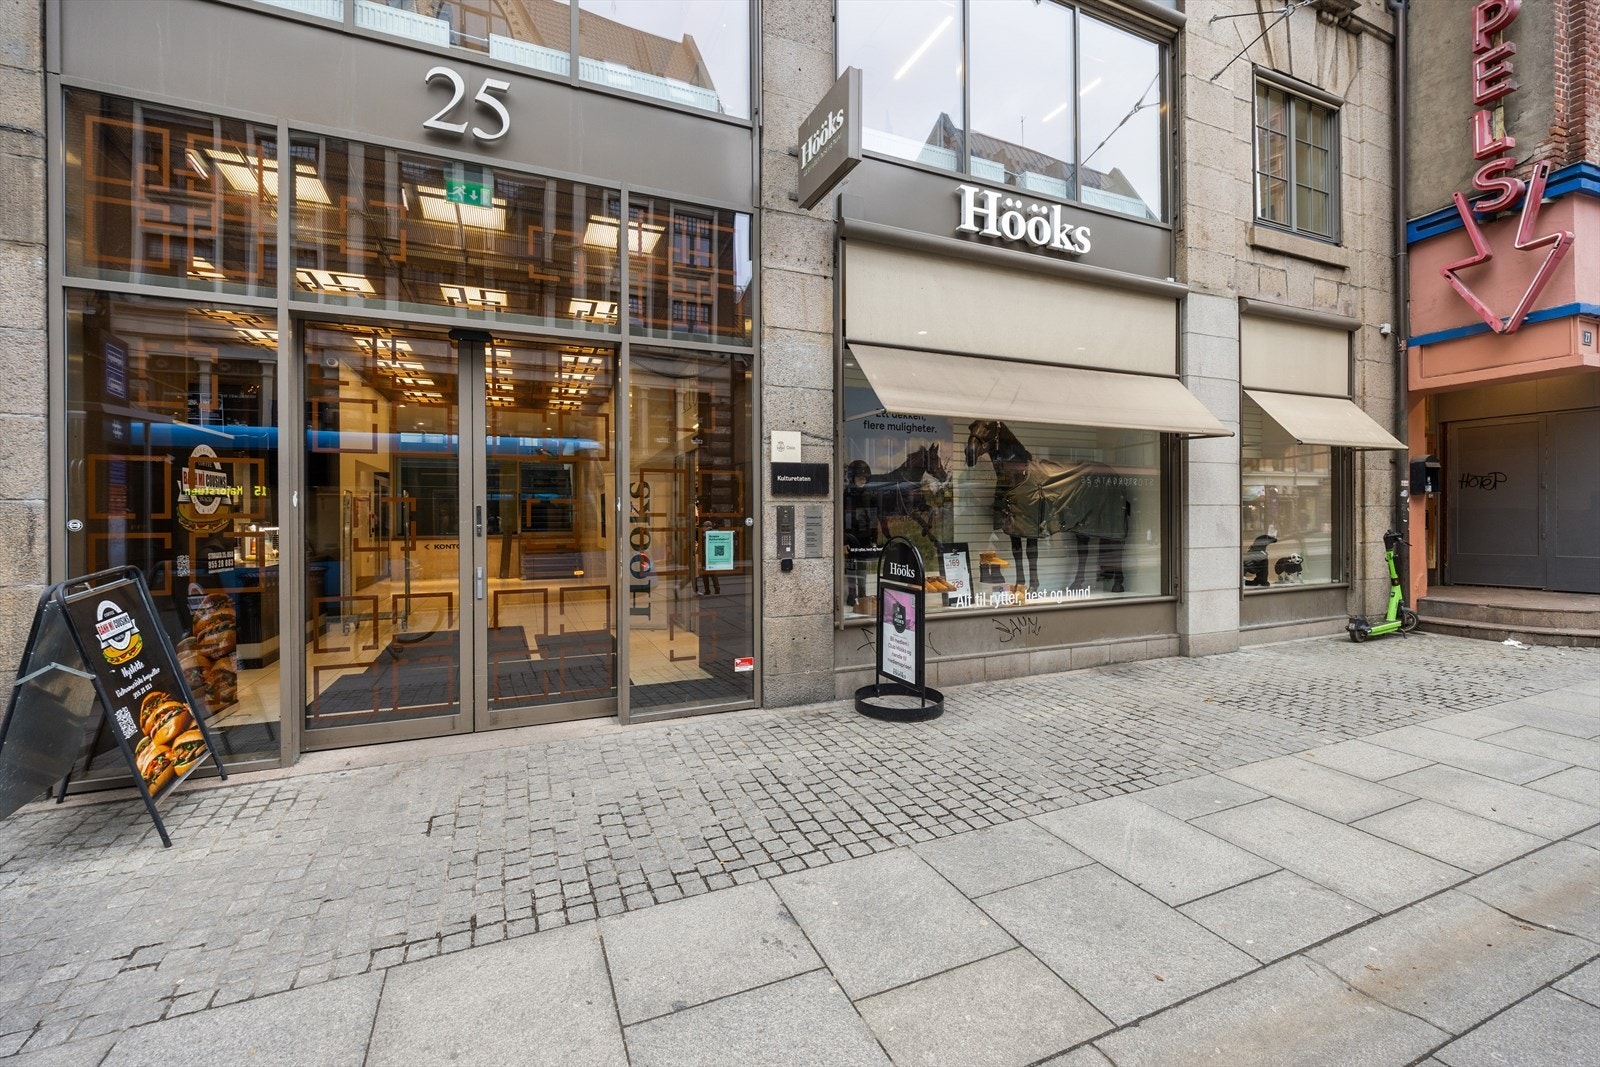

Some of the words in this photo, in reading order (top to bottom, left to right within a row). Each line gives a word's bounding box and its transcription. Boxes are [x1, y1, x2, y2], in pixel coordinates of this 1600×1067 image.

[423, 66, 510, 140] 25
[800, 108, 844, 170] Hööks
[955, 184, 1091, 256] Hööks
[1583, 332, 1591, 343] 27
[863, 420, 885, 430] flere
[887, 423, 937, 434] muligheter.
[890, 562, 915, 578] Hööks
[949, 559, 960, 567] 169
[956, 593, 973, 608] Alt
[975, 591, 986, 606] til
[990, 589, 1022, 609] rytter,
[1025, 588, 1048, 602] hest
[1050, 590, 1063, 603] og
[1066, 585, 1091, 600] hund
